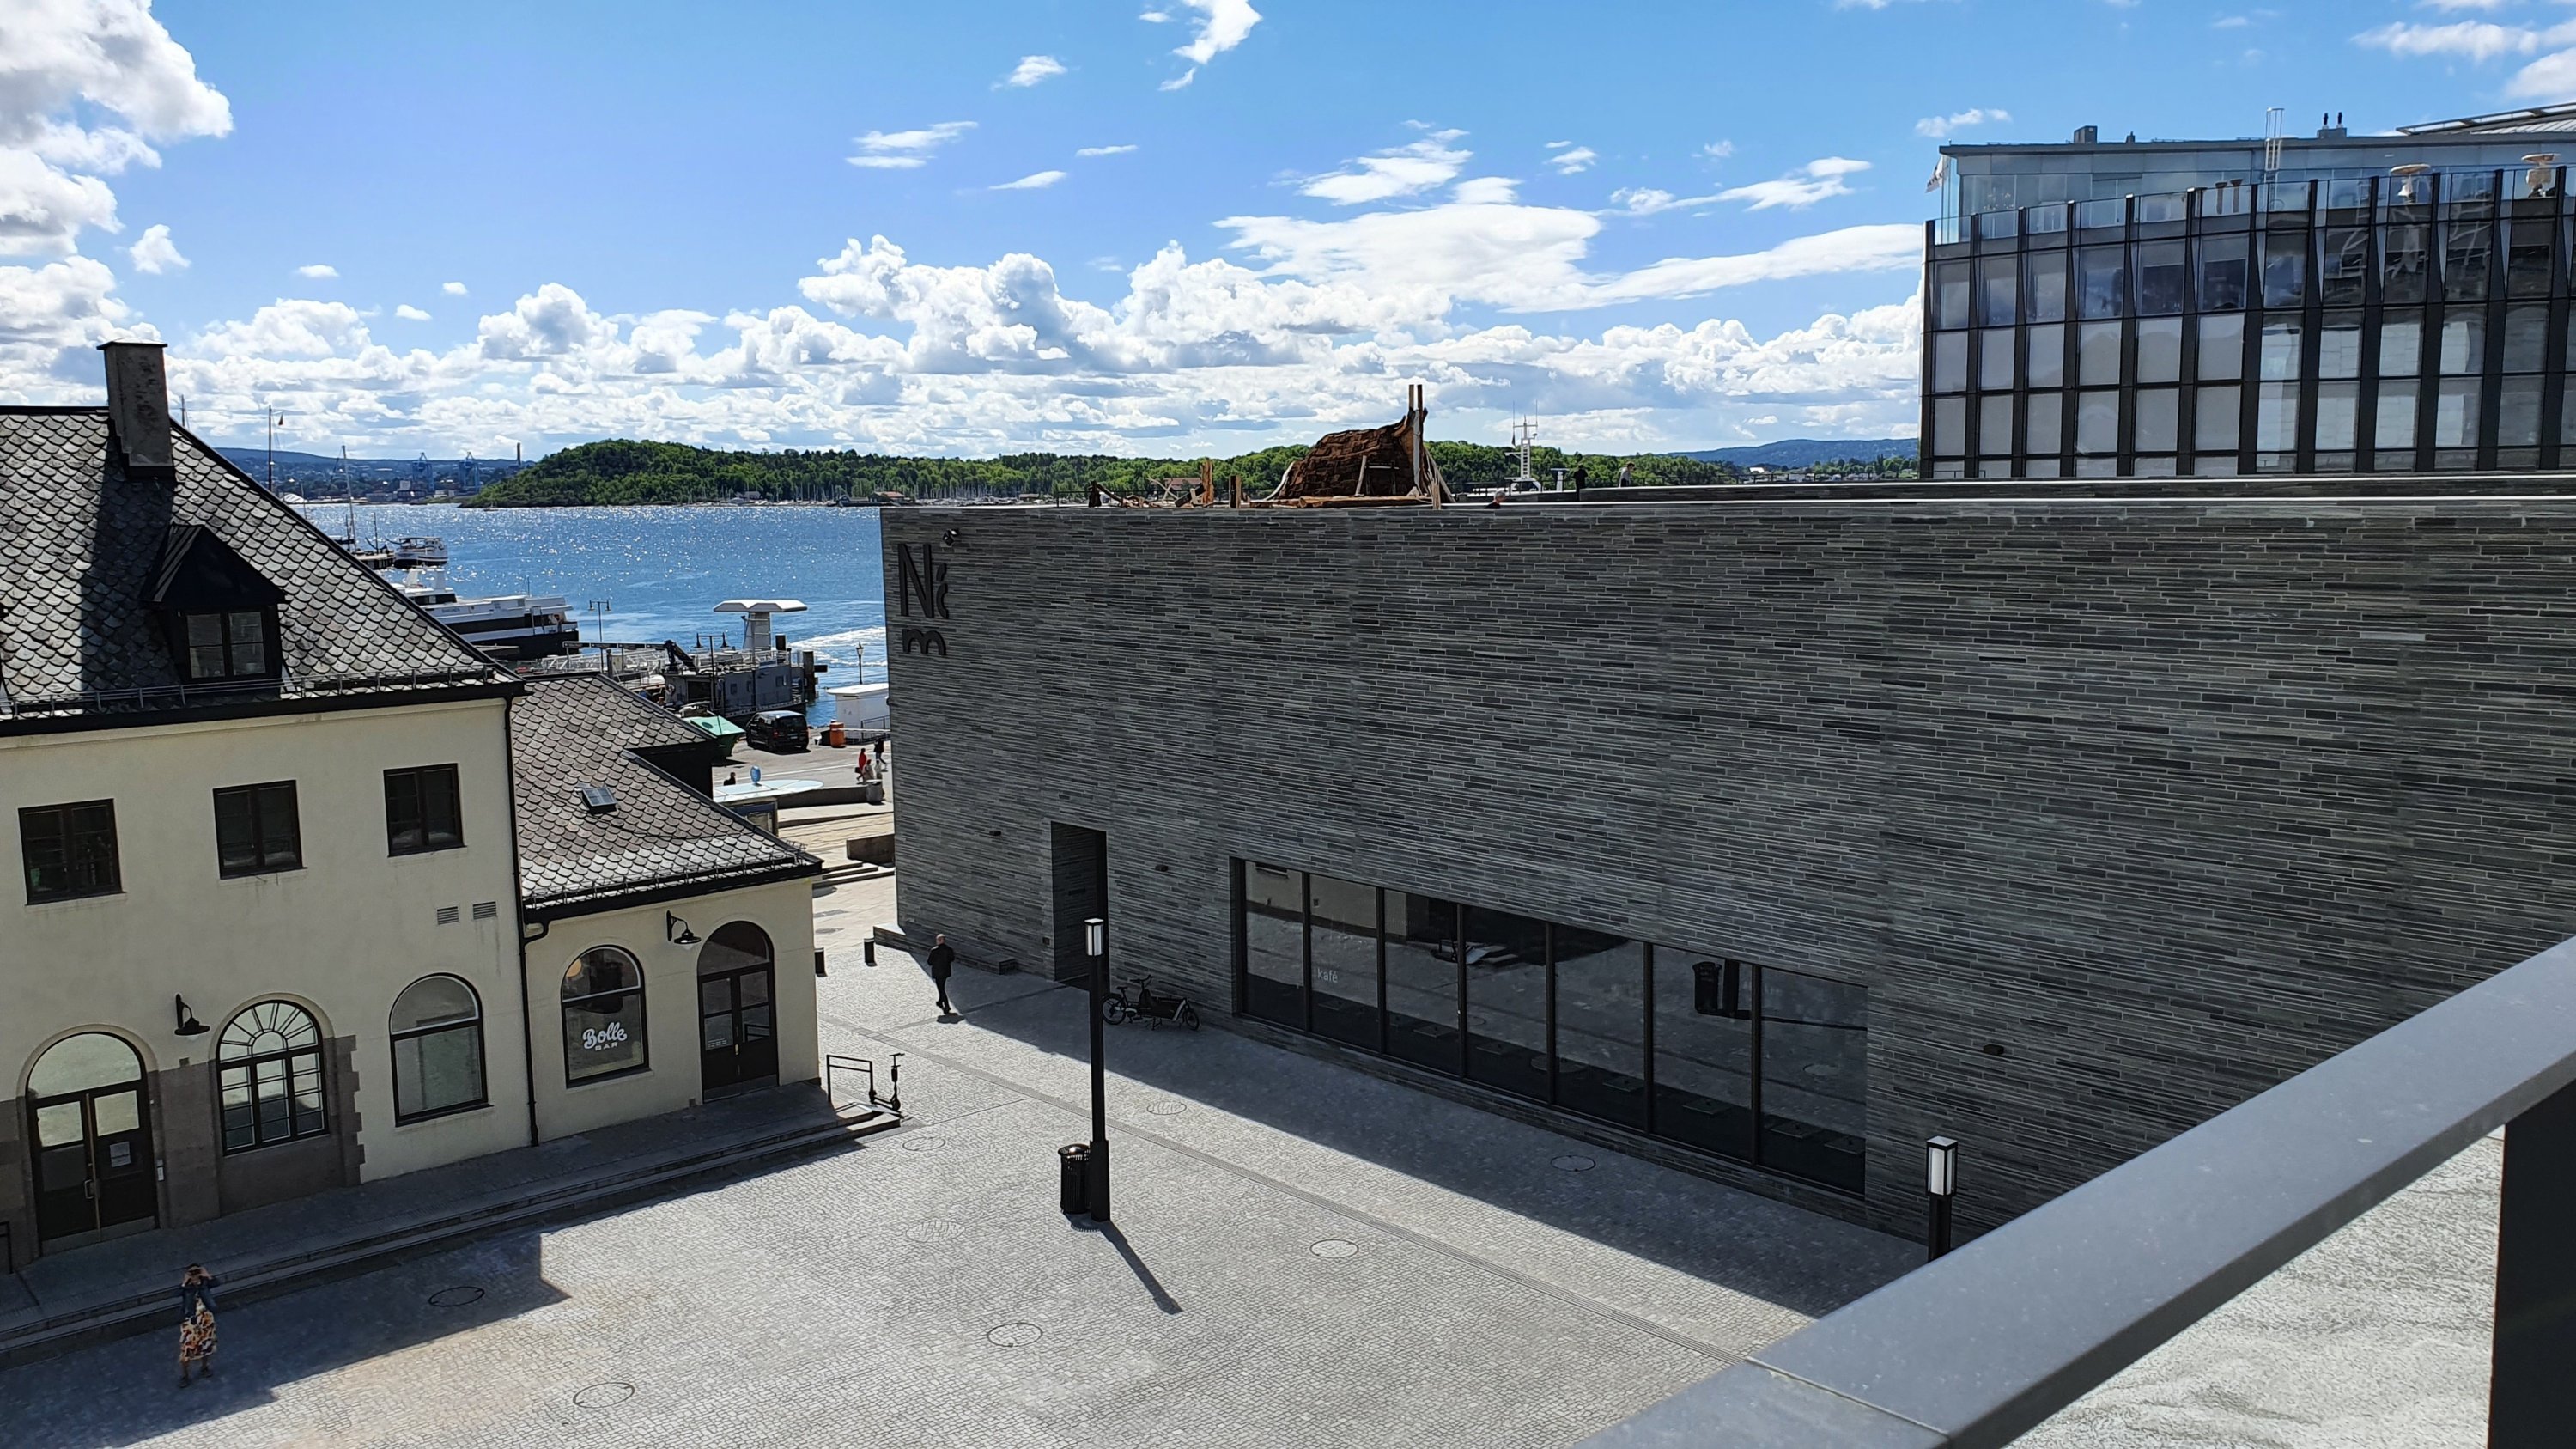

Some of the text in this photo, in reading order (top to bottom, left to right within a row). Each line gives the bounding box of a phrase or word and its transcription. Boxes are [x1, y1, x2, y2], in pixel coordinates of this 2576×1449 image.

[1317, 967, 1338, 983] kafé
[582, 1021, 628, 1049] Bolle
[594, 1041, 618, 1051] BAR
